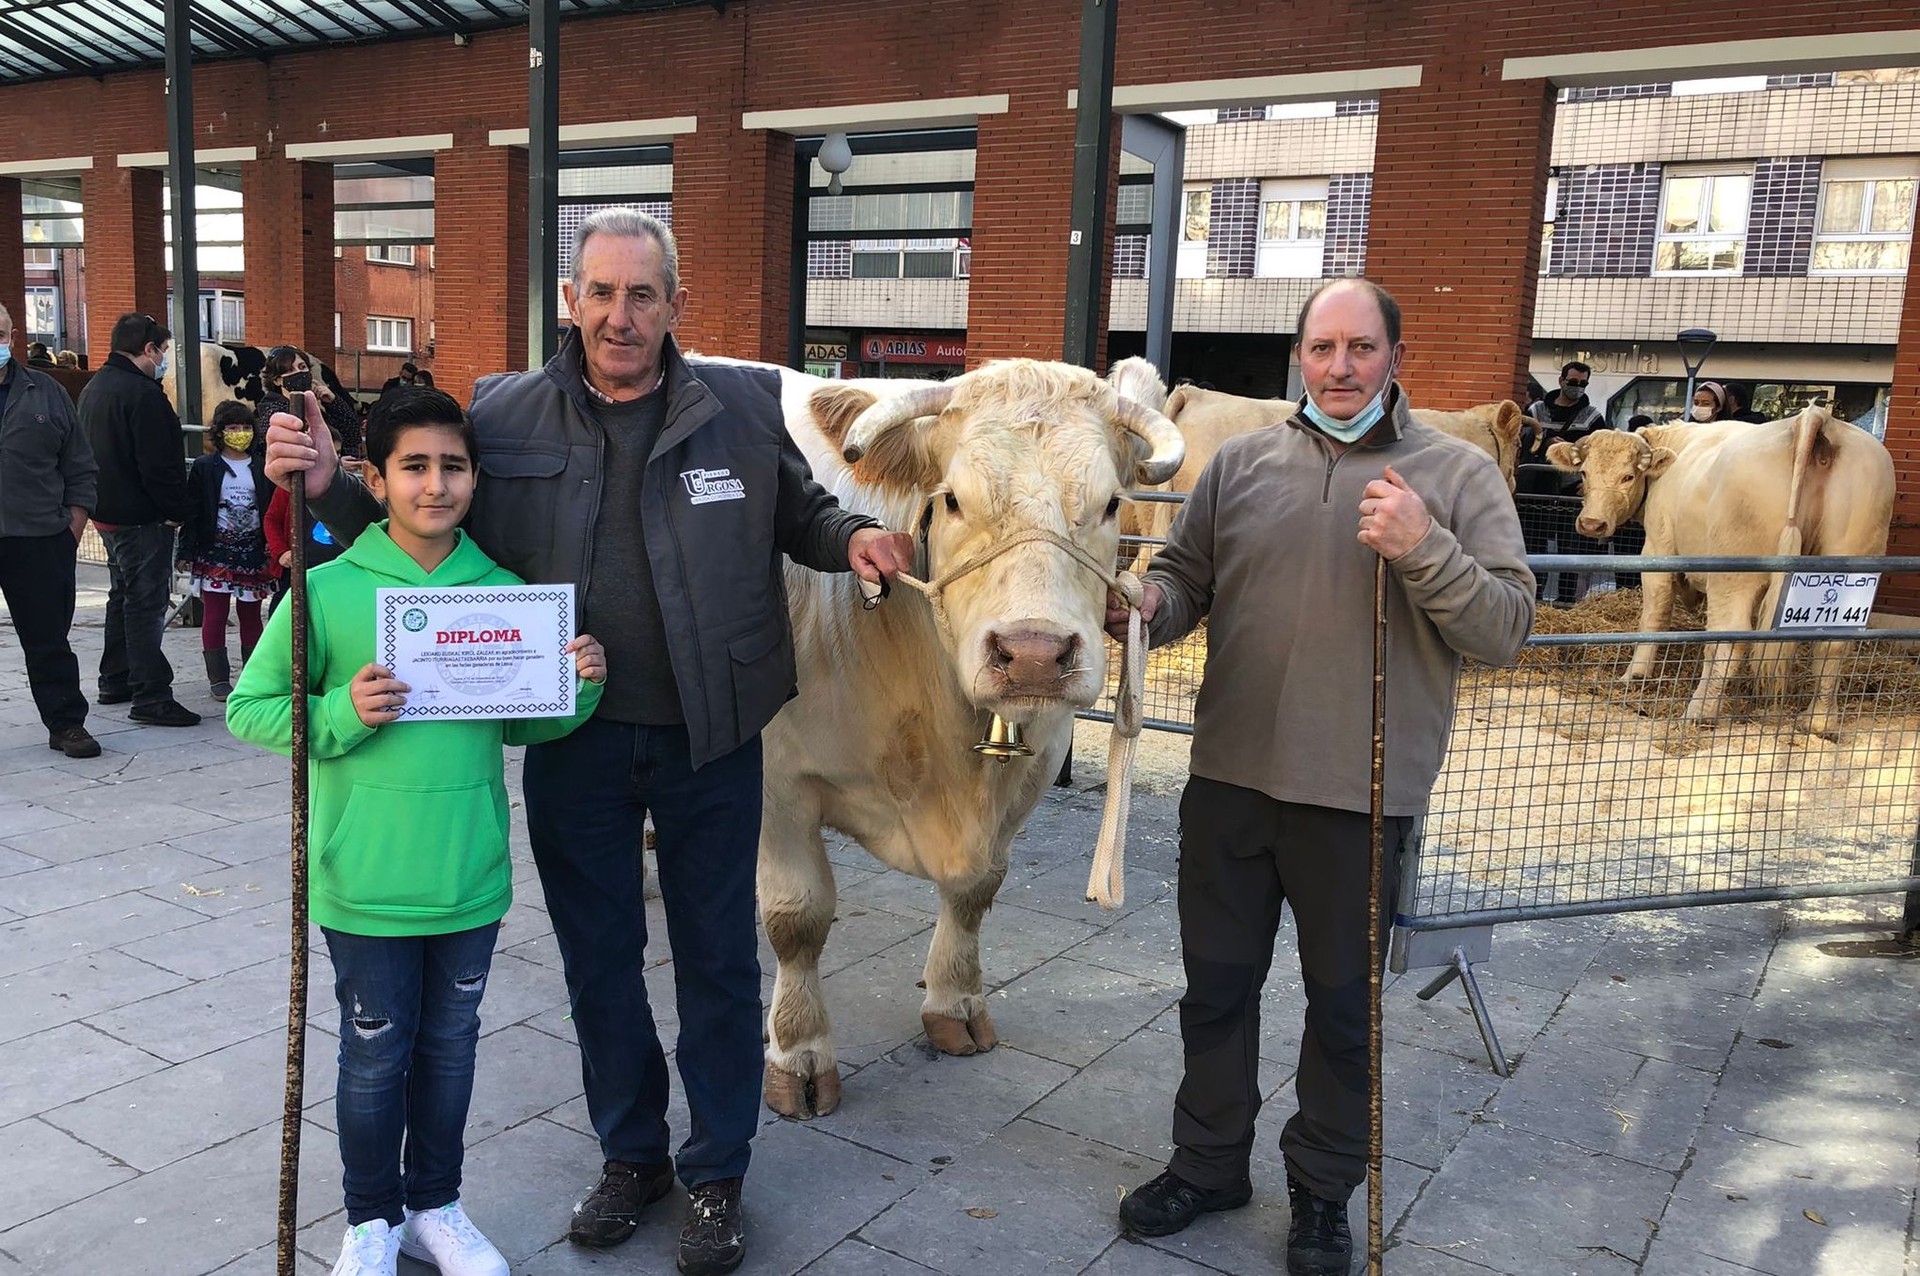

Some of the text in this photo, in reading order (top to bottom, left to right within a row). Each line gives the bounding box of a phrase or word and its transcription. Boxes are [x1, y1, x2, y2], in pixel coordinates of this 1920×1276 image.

[1072, 233, 1079, 243] 3
[805, 345, 846, 359] ADAS
[885, 341, 927, 357] ARIAS
[1784, 607, 1869, 623] 944 711 441
[436, 629, 522, 645] DIPLOMA
